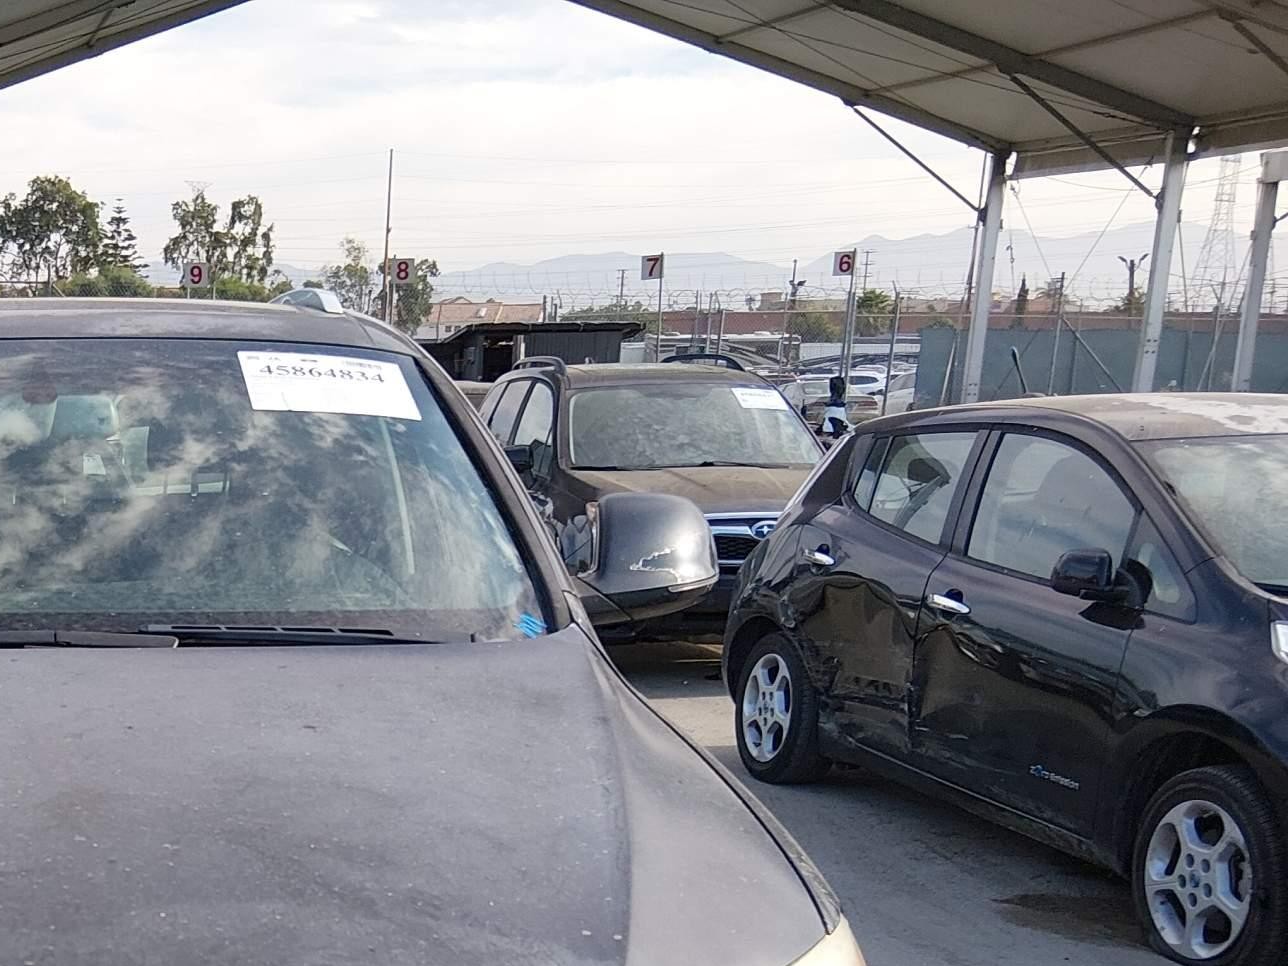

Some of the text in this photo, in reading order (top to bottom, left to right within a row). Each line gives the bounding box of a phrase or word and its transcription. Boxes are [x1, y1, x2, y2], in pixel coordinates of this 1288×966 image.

[397, 261, 409, 280] 8
[647, 257, 660, 277] 7
[839, 254, 851, 273] 6
[190, 265, 202, 284] 9
[260, 364, 386, 384] 45864834
